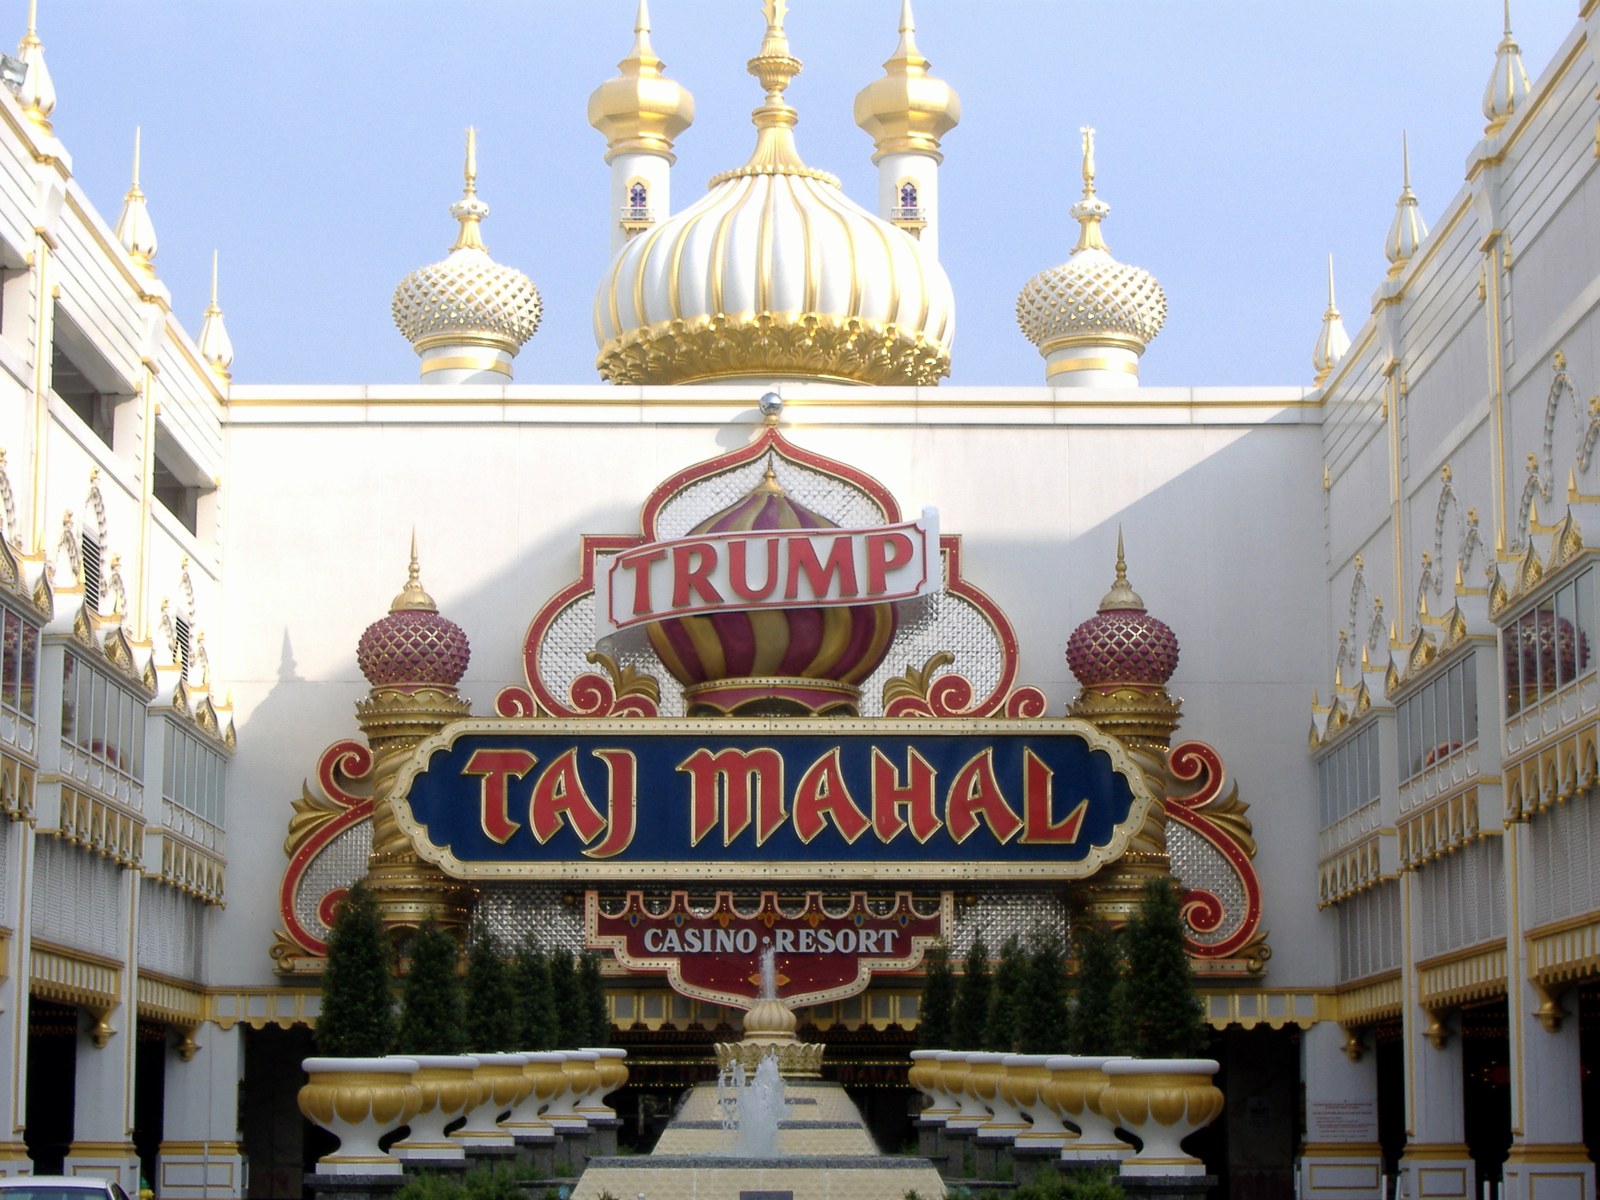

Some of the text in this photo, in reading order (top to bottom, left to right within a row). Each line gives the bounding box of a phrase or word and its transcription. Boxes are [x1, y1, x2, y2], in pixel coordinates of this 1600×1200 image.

[622, 532, 914, 616] TRUMP
[461, 745, 1089, 858] TAJ MAHAL
[644, 928, 899, 953] CASINO RESORT
